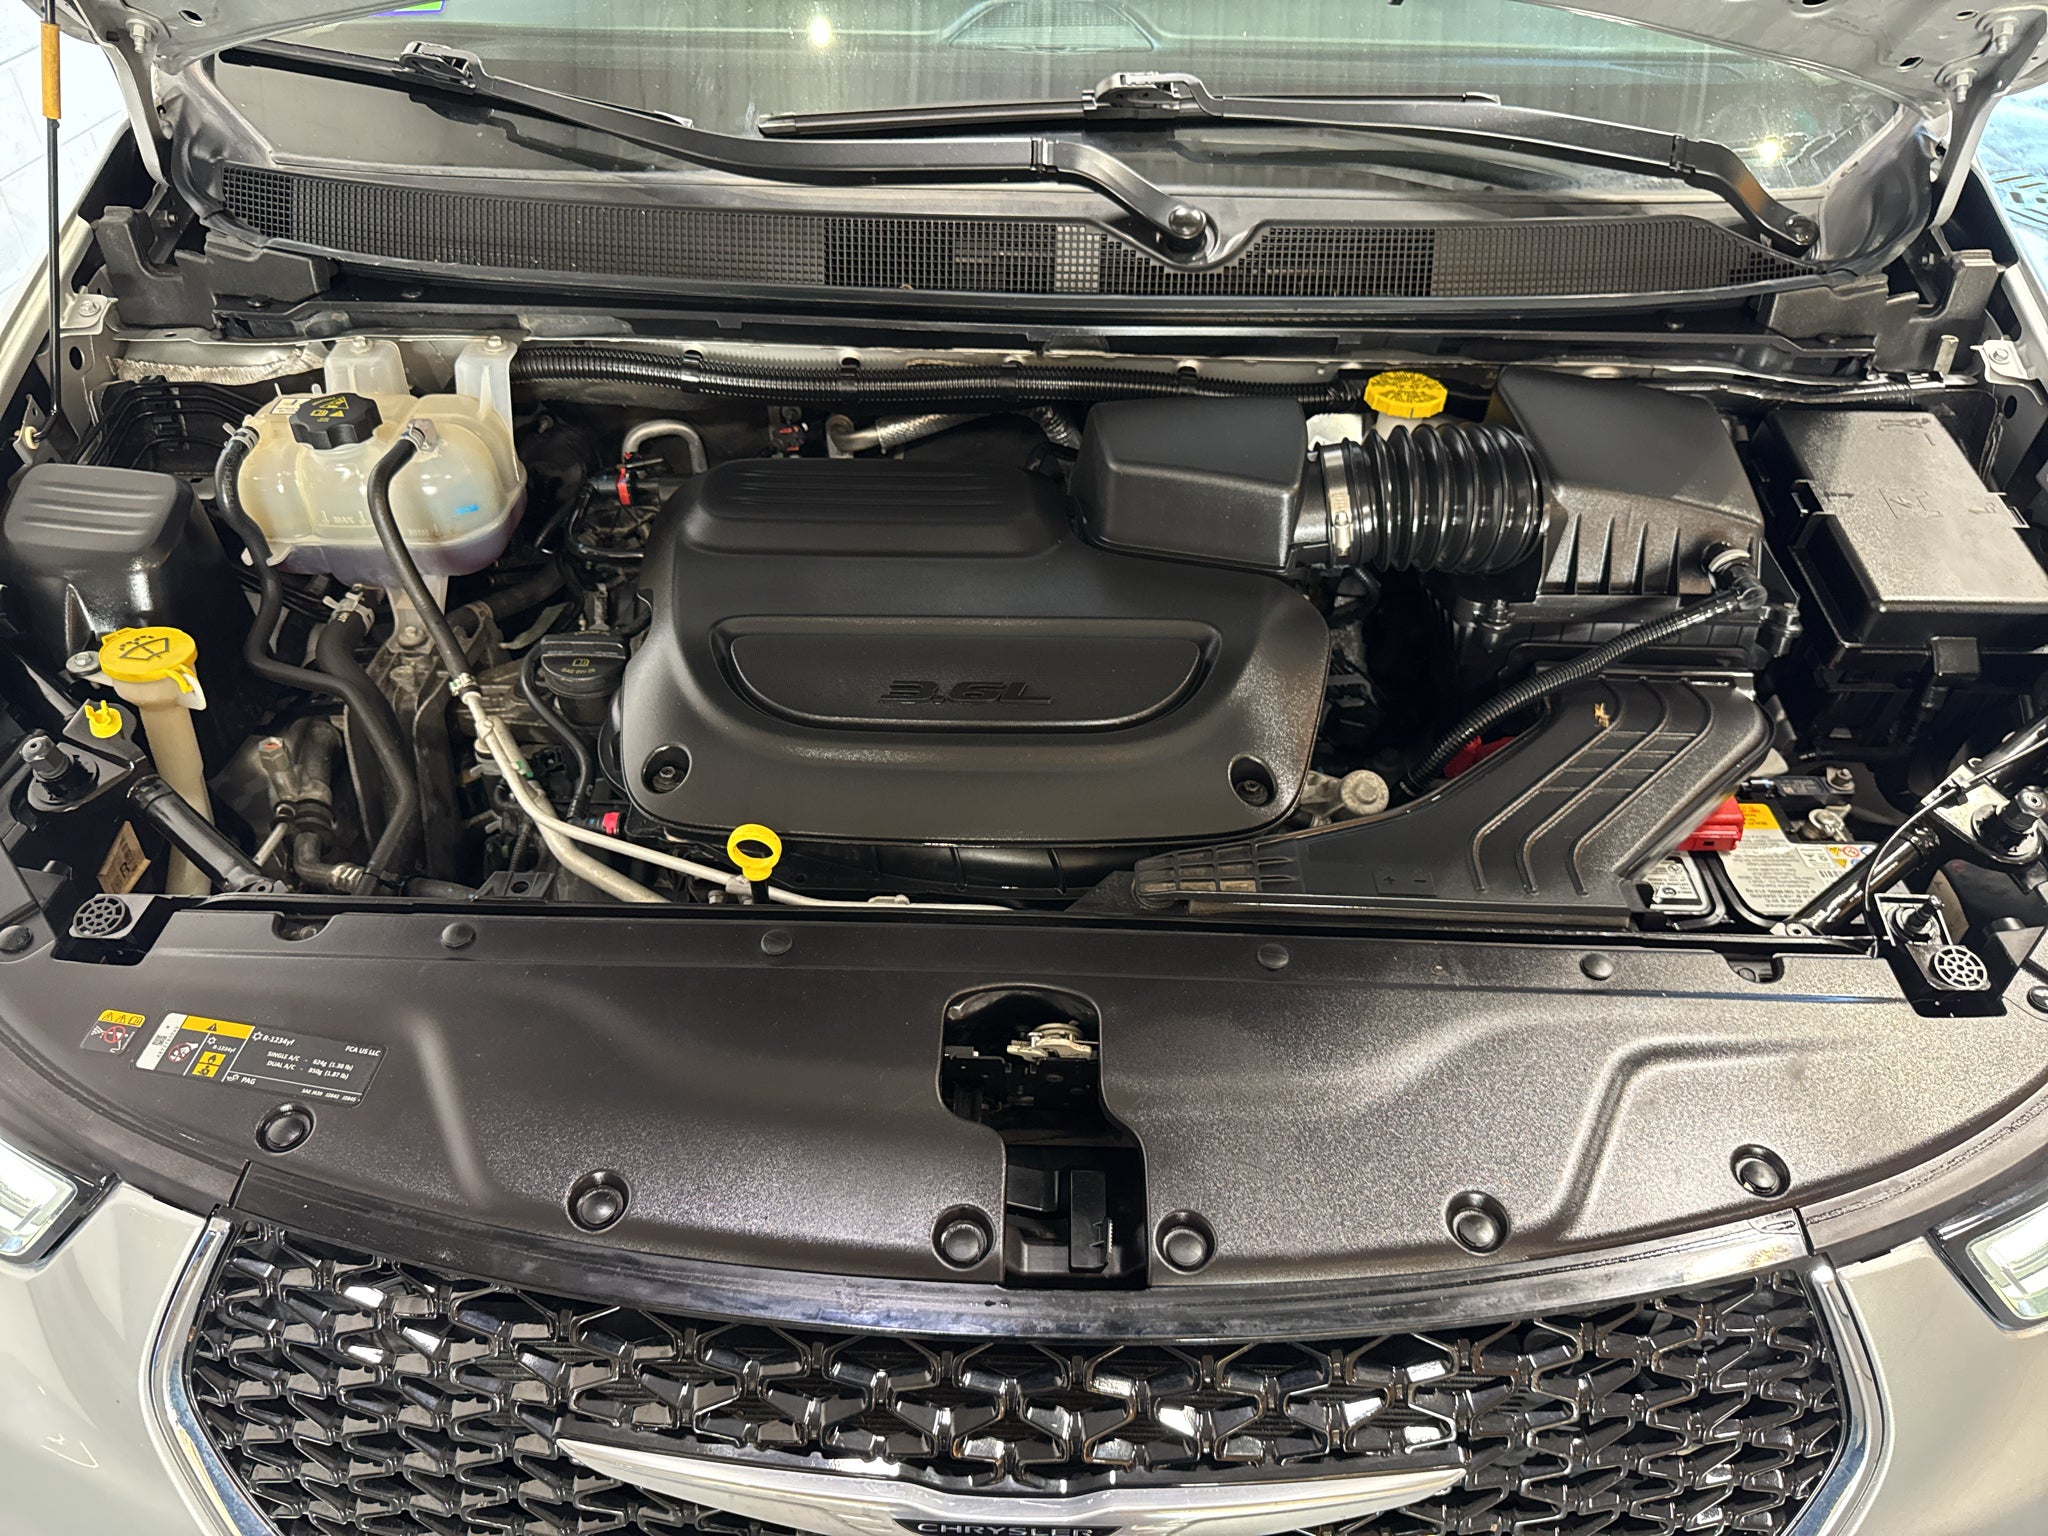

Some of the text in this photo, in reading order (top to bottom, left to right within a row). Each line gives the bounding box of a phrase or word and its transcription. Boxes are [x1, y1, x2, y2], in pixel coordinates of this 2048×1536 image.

[879, 680, 1052, 703] 3.6L
[262, 1034, 295, 1046] R-1234yf
[267, 1051, 289, 1061] SINGLE
[288, 1054, 301, 1062] A/C
[345, 1045, 381, 1057] FCA US LLC
[266, 1060, 283, 1069] DUAL
[283, 1062, 296, 1071] A/C
[240, 1076, 256, 1085] PAG
[917, 1523, 1093, 1536] CHRYSLER
